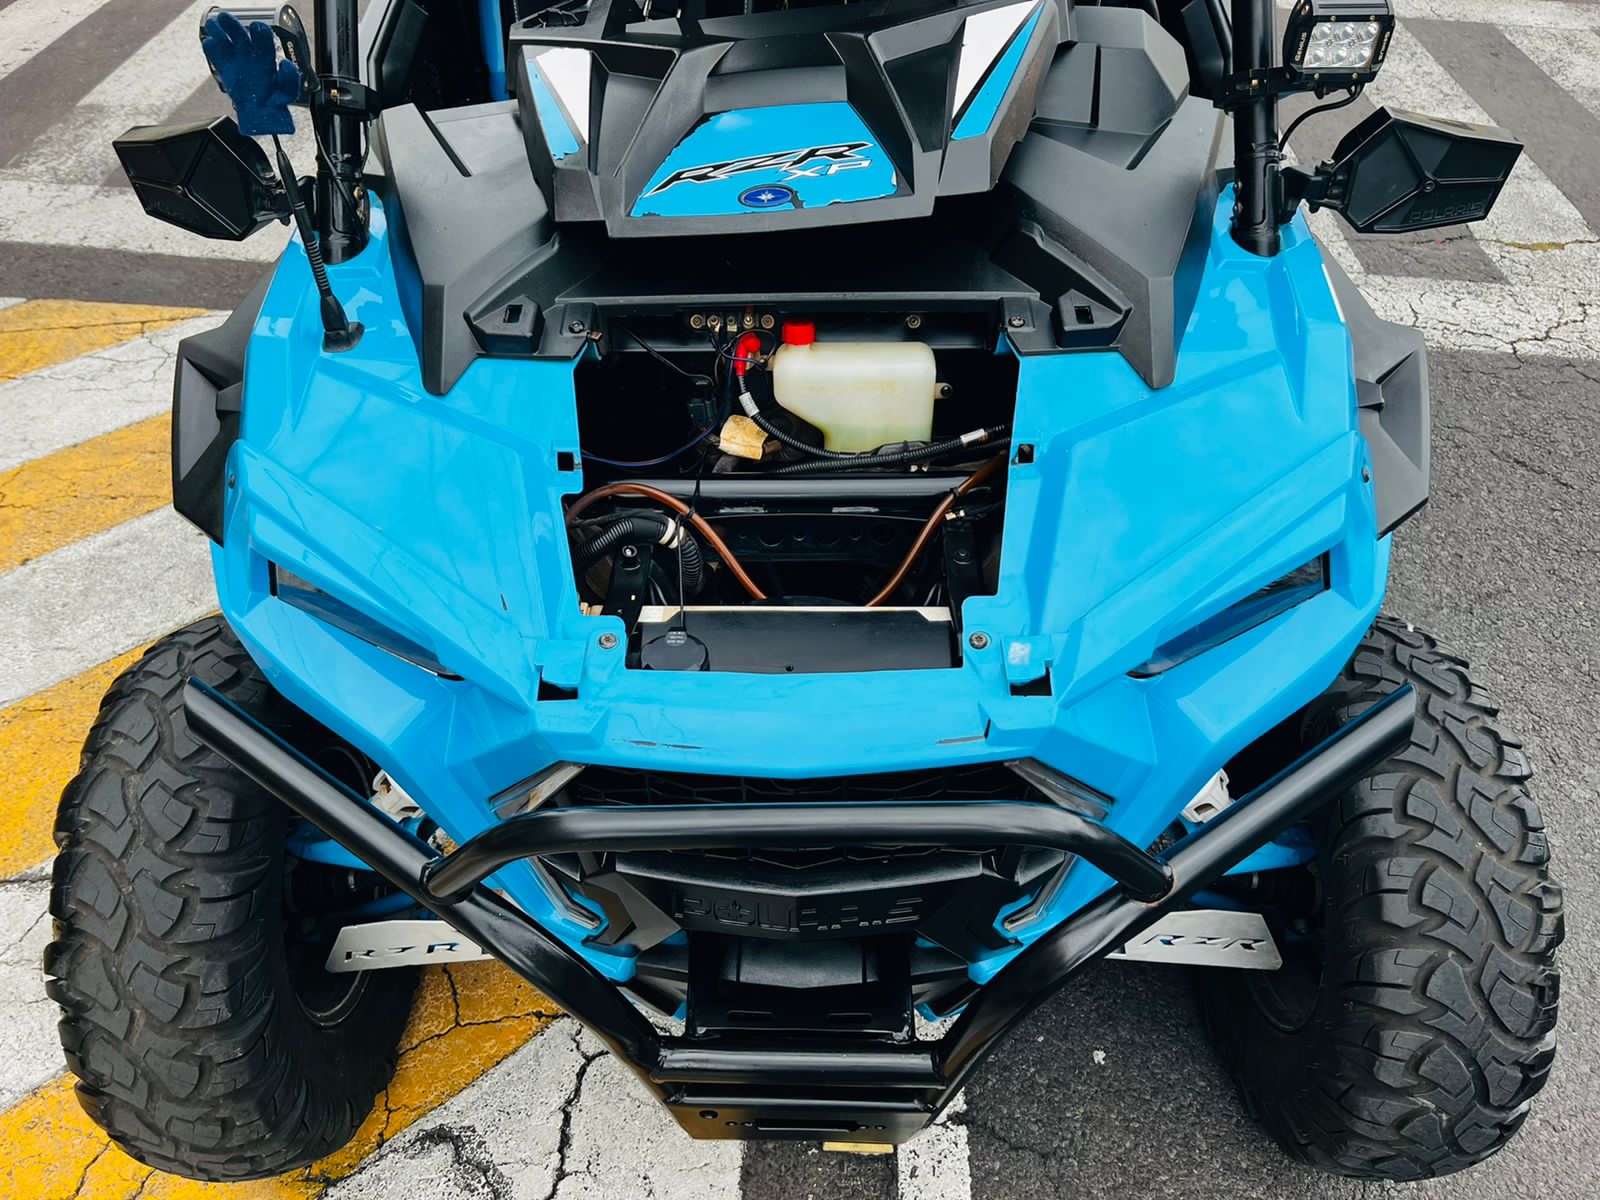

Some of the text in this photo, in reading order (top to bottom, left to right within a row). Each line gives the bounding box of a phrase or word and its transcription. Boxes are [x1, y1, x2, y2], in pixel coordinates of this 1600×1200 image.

[642, 140, 874, 198] RZR
[777, 159, 872, 182] XP
[344, 942, 461, 963] RZR
[1143, 933, 1267, 952] RZR
